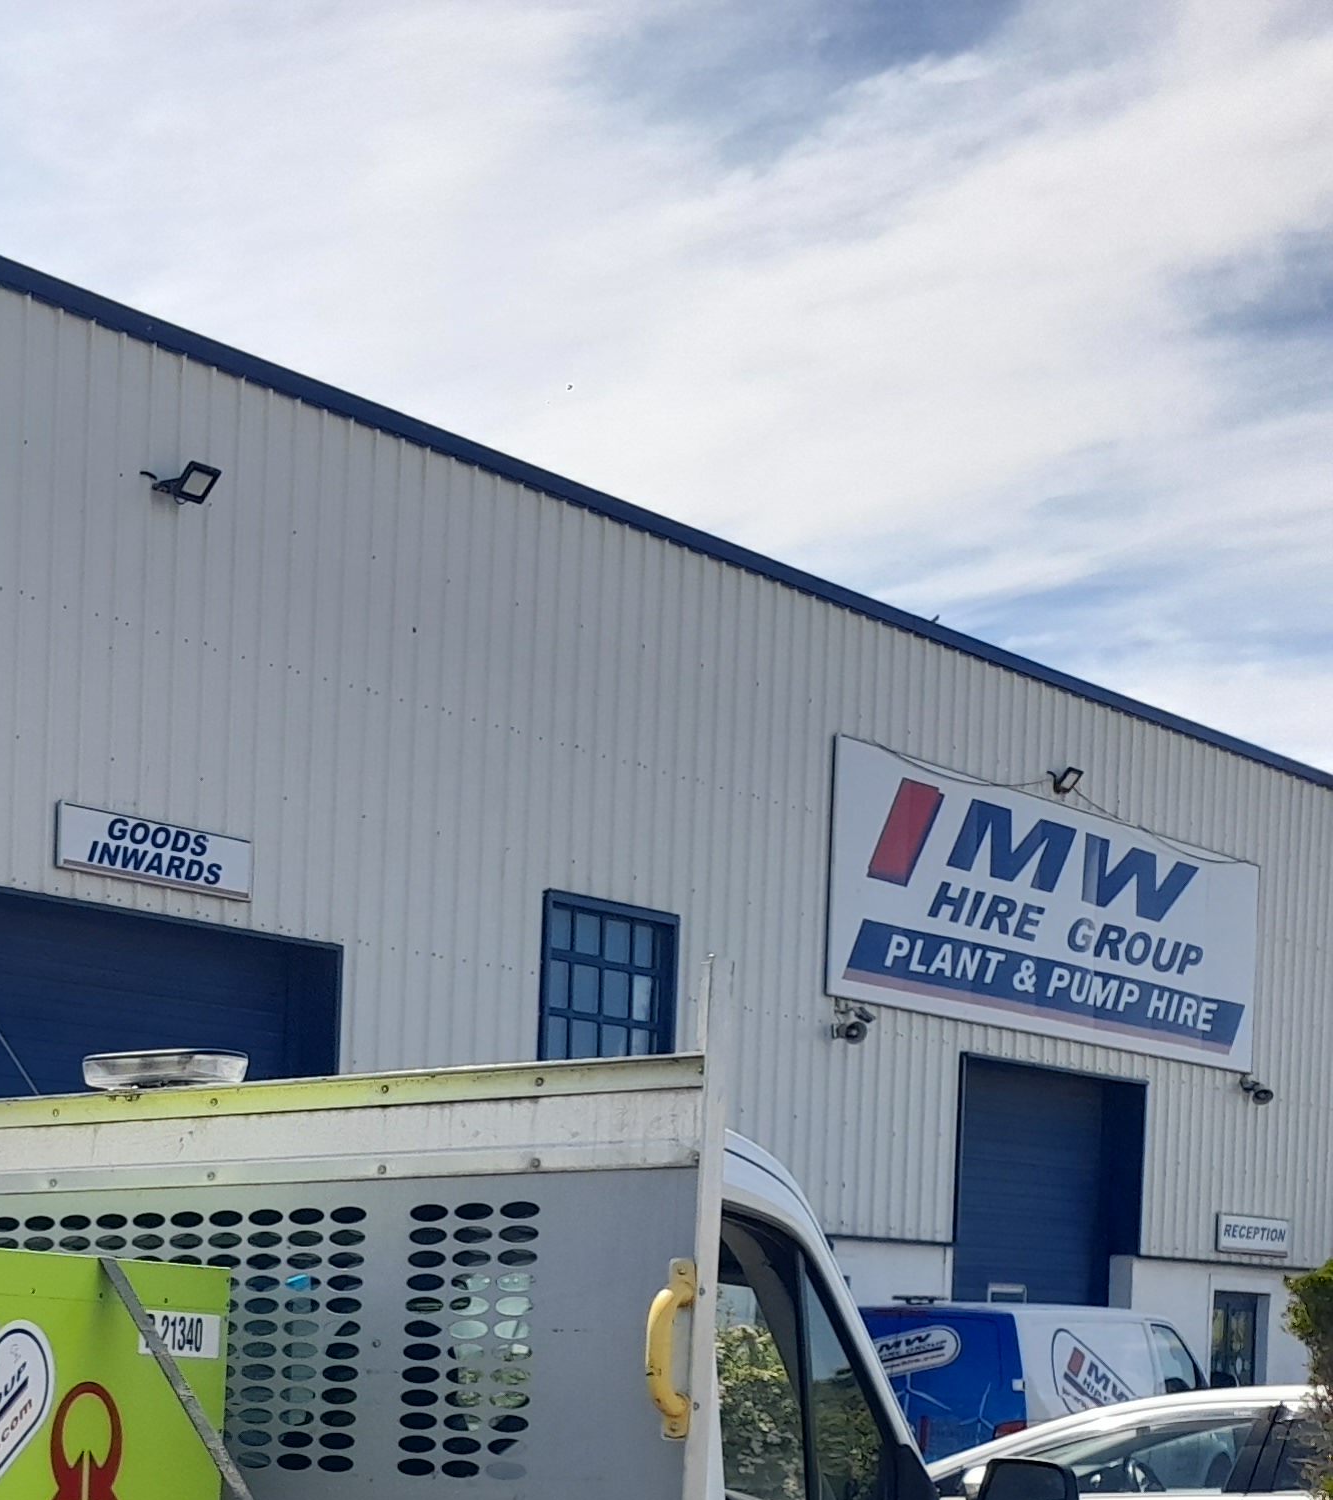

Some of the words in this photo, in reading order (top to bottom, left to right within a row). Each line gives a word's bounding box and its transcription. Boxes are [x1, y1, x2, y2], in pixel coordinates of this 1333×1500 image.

[107, 818, 209, 857] GOODS
[87, 841, 223, 885] INWARDS
[945, 798, 1200, 923] MW
[927, 881, 1046, 941] HIRE
[1066, 917, 1204, 976] GROUP
[884, 934, 1006, 984] PLANT
[1011, 959, 1037, 994] &
[1046, 967, 1140, 1012] PUMP
[1147, 988, 1219, 1032] HIRE
[1223, 1224, 1286, 1242] RECEPTION
[161, 1315, 203, 1352] 21340
